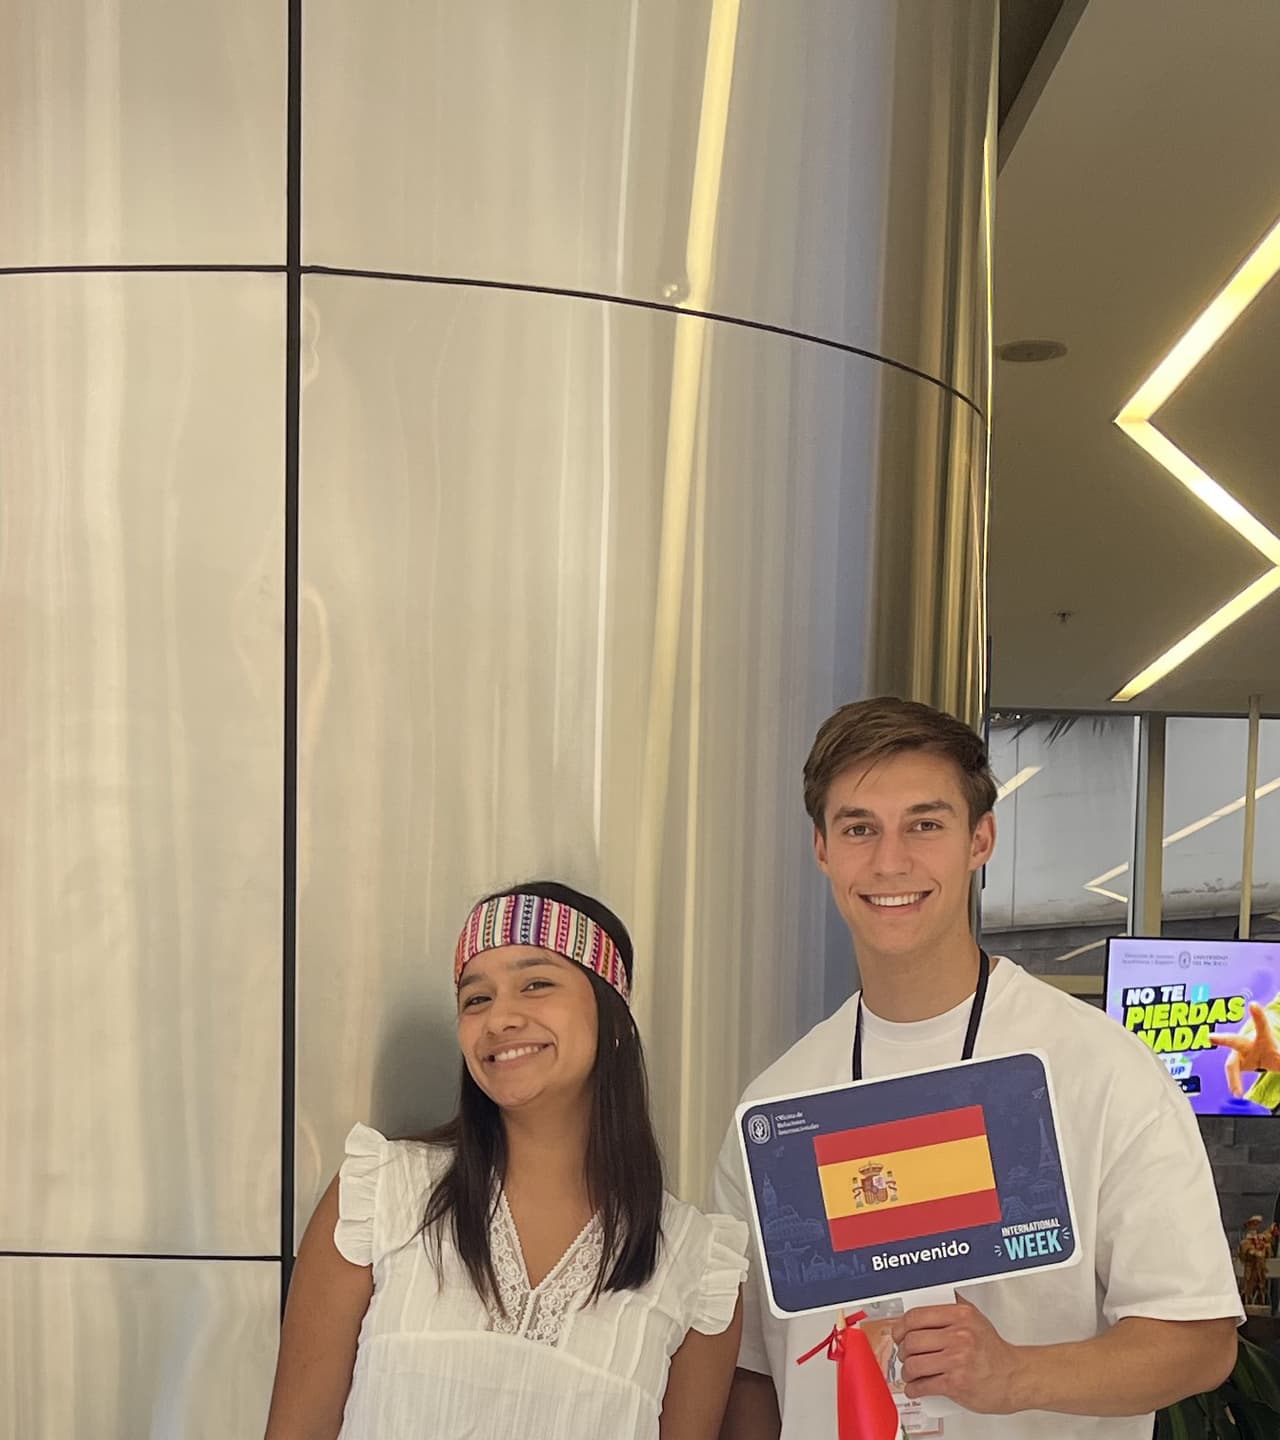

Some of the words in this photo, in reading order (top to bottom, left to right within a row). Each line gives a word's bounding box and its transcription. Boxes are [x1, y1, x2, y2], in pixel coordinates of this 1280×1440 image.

[1125, 988, 1155, 1006] NO
[1160, 985, 1185, 1003] TE
[1125, 996, 1245, 1031] PIERDAS
[1137, 1025, 1212, 1053] NADA
[1001, 1217, 1061, 1237] INTERNATIONAL
[871, 1239, 971, 1272] Bienvenido
[1004, 1229, 1063, 1261] WEEK
